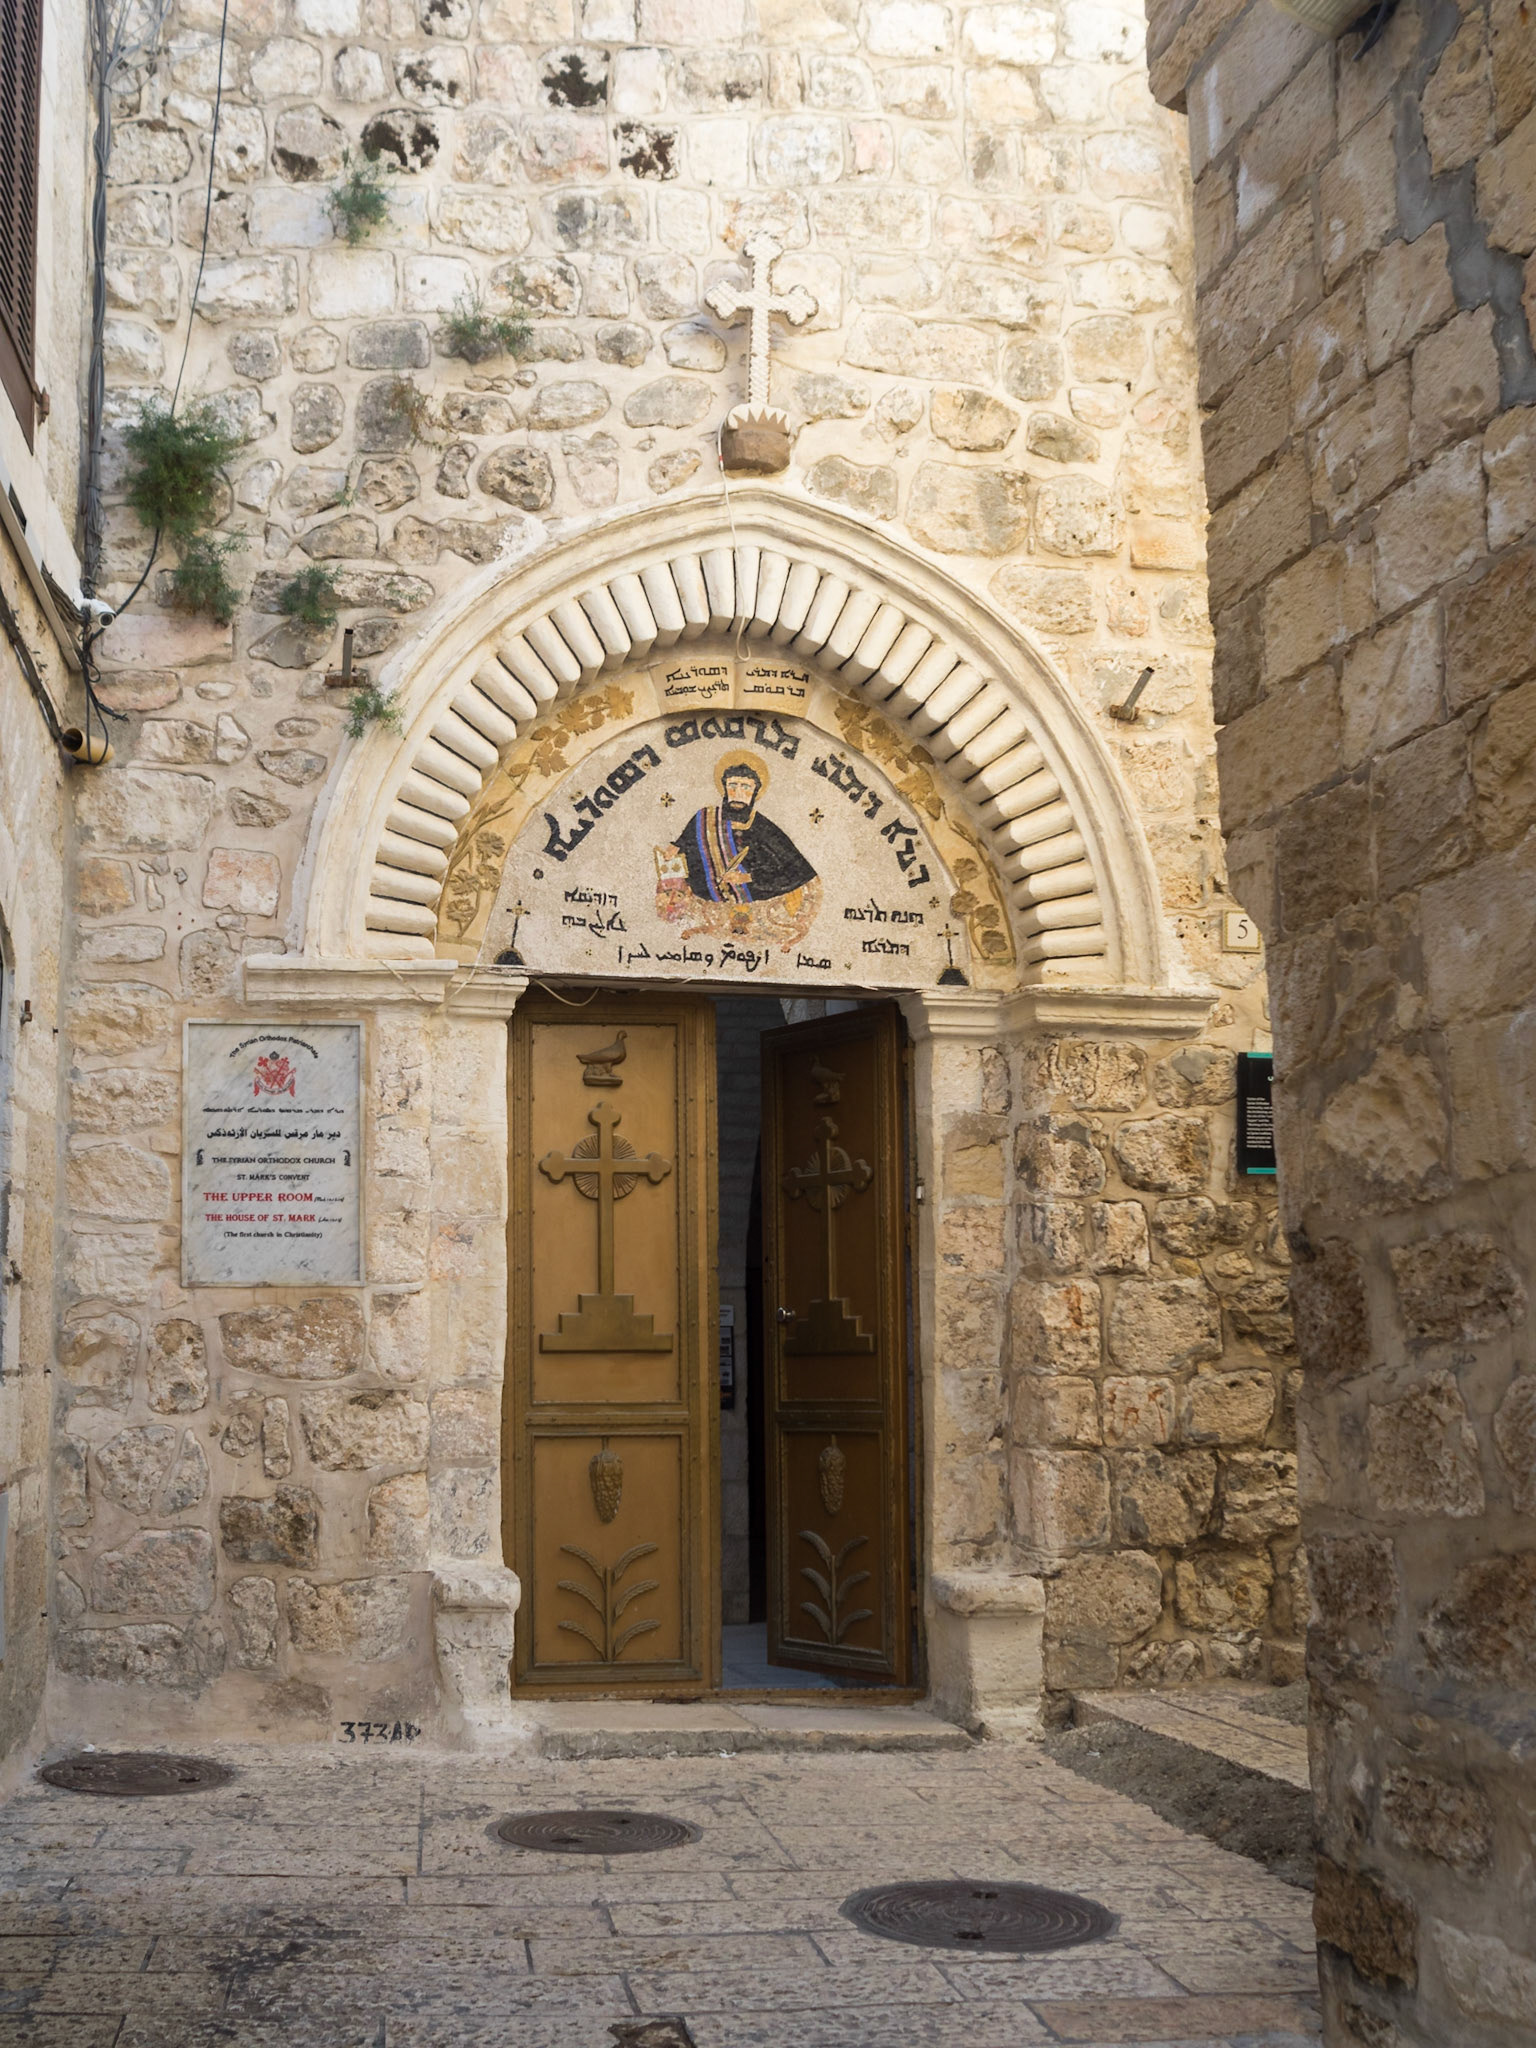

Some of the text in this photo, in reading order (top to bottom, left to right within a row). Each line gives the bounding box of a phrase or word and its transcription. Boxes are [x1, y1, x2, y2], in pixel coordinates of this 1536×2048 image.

[1237, 919, 1249, 940] 5
[229, 1035, 319, 1059] The Syrian Orthodox Patriarchate
[284, 1128, 309, 1140] مرقس
[311, 1129, 324, 1140] مار
[327, 1129, 342, 1141] دير
[203, 1192, 228, 1202] THE
[232, 1192, 273, 1202] UPPER
[278, 1192, 313, 1202] ROOM
[205, 1213, 224, 1222] THE
[225, 1214, 256, 1222] HOUSE
[257, 1214, 269, 1222] OF
[272, 1214, 286, 1222] ST.
[288, 1214, 316, 1222] MARK
